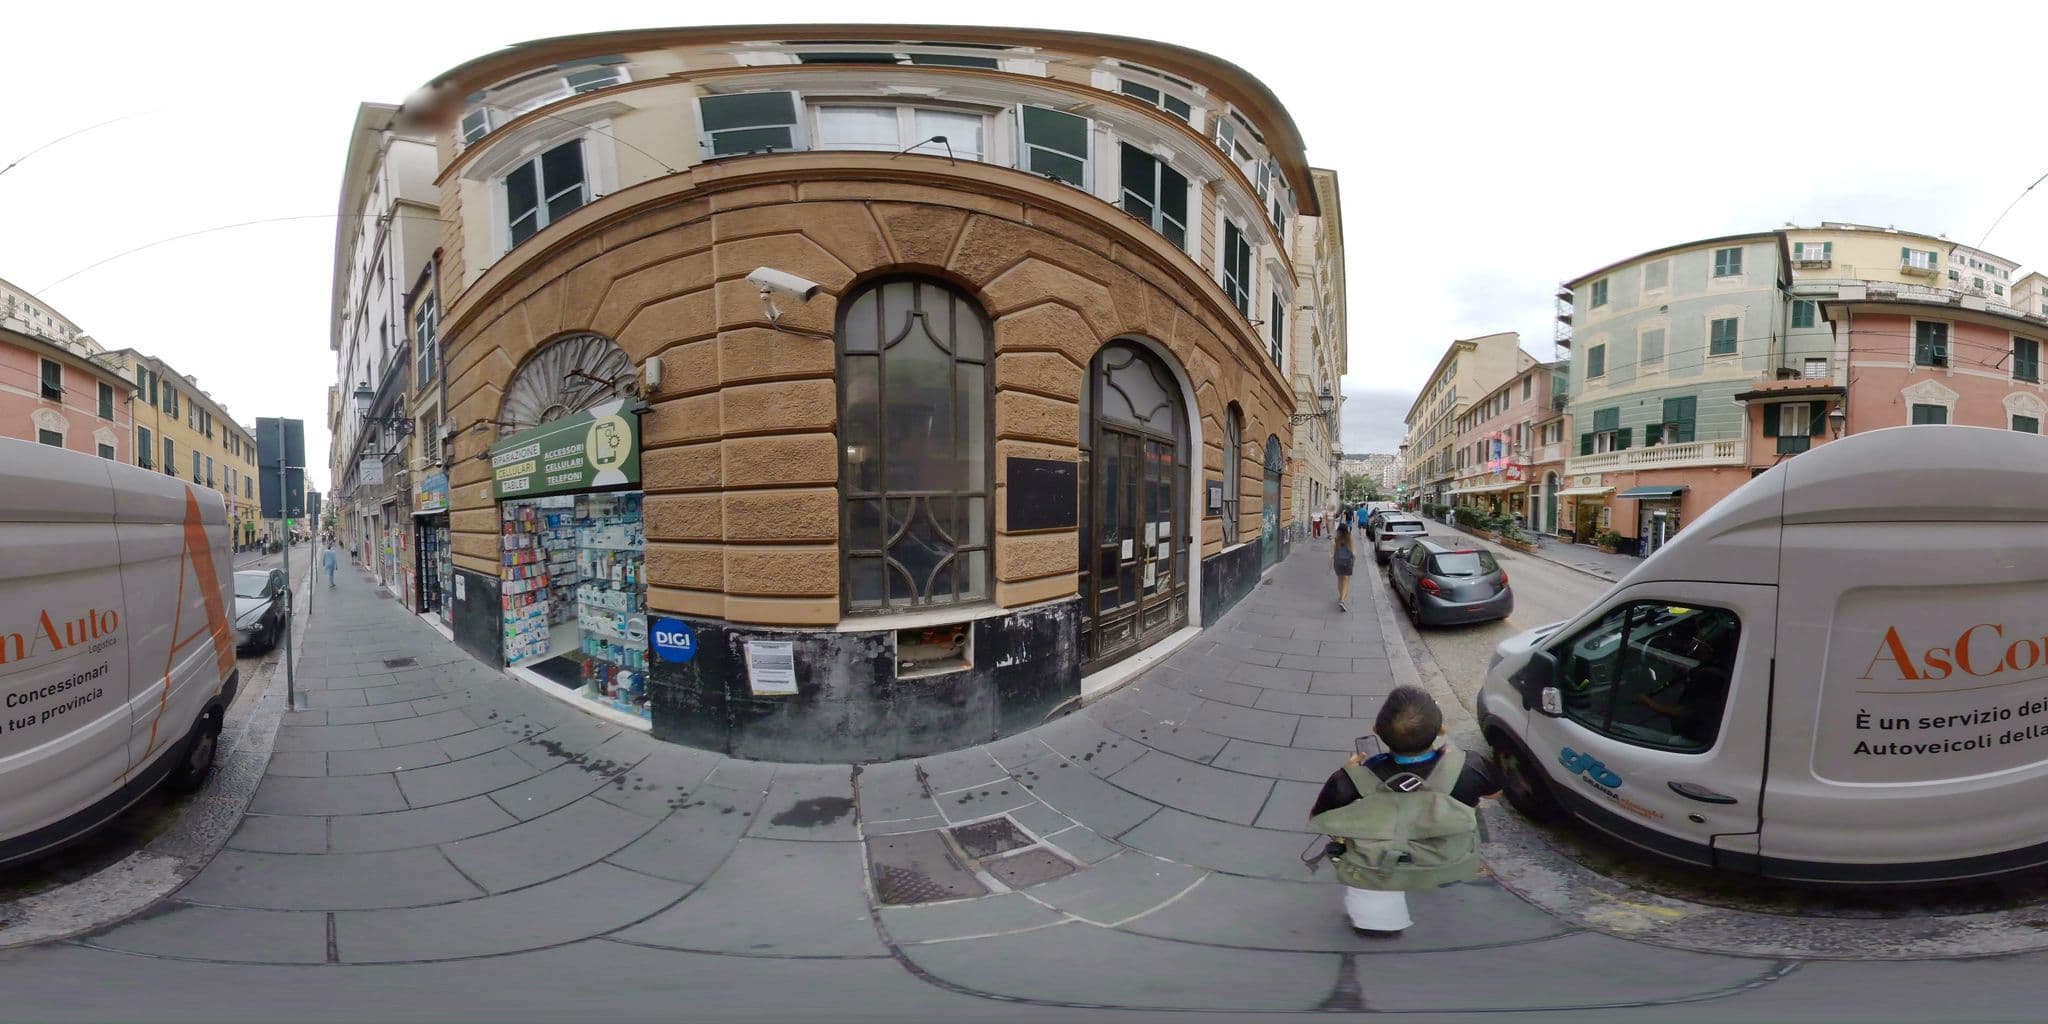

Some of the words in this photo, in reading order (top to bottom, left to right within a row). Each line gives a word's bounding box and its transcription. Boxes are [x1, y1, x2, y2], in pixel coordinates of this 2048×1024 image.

[493, 445, 539, 465] RIPARAZIONE
[544, 443, 584, 459] ACCESSORI
[497, 463, 534, 478] CELLULARI
[545, 457, 584, 472] CELLULARI
[504, 479, 528, 491] TABLET
[547, 471, 583, 484] TELEFONI
[88, 638, 117, 654] Logistica
[656, 631, 690, 646] DIGI
[1855, 623, 2048, 681] AsCo
[6, 661, 108, 708] Concessionari
[8, 715, 36, 732] tua
[41, 687, 103, 725] provincia
[1856, 709, 1871, 730] È
[1879, 717, 1910, 730] un
[1918, 707, 2011, 729] servizio
[2018, 696, 2048, 717] dei
[1853, 735, 1992, 756] Autoveicoli
